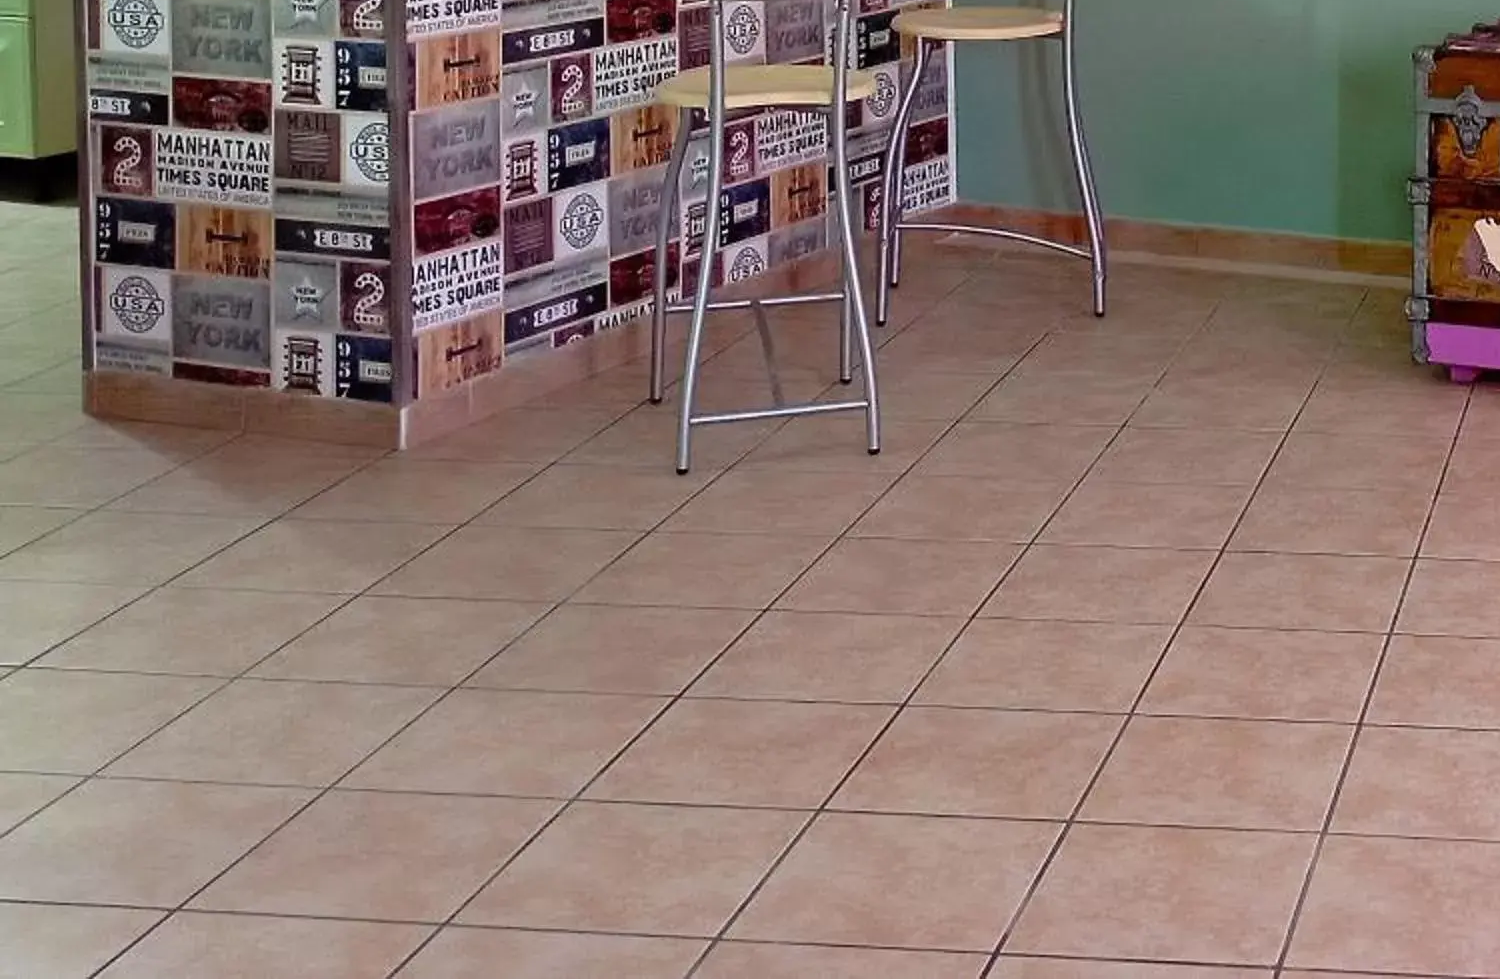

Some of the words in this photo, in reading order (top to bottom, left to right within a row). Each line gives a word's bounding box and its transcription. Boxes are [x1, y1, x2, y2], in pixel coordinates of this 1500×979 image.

[112, 12, 158, 26] USA
[190, 4, 254, 31] NEW
[184, 34, 264, 63] YORK
[595, 39, 678, 73] MANHATTAN
[561, 63, 584, 114] 2
[595, 79, 629, 101] TIMES
[111, 101, 127, 113] ST
[157, 133, 271, 162] MANHATTAN
[430, 117, 487, 150] NEW
[758, 143, 787, 160] TIMES
[788, 132, 825, 155] SQUARE
[113, 136, 142, 188] 2
[157, 155, 215, 169] MADISON
[219, 160, 270, 174] AVENUE
[425, 143, 494, 181] YORK
[729, 130, 749, 176] 2
[157, 168, 202, 186] TIMES
[207, 172, 270, 193] SQUARE
[353, 236, 368, 249] ST
[412, 242, 500, 286] ANHATTAN
[411, 278, 453, 297] ADISON
[457, 264, 500, 284] AVENUE
[113, 296, 161, 314] USA
[190, 293, 253, 321] NEW
[355, 272, 385, 325] 2
[412, 293, 441, 316] MES
[446, 276, 501, 306] SQUARE
[187, 322, 261, 352] YORK
